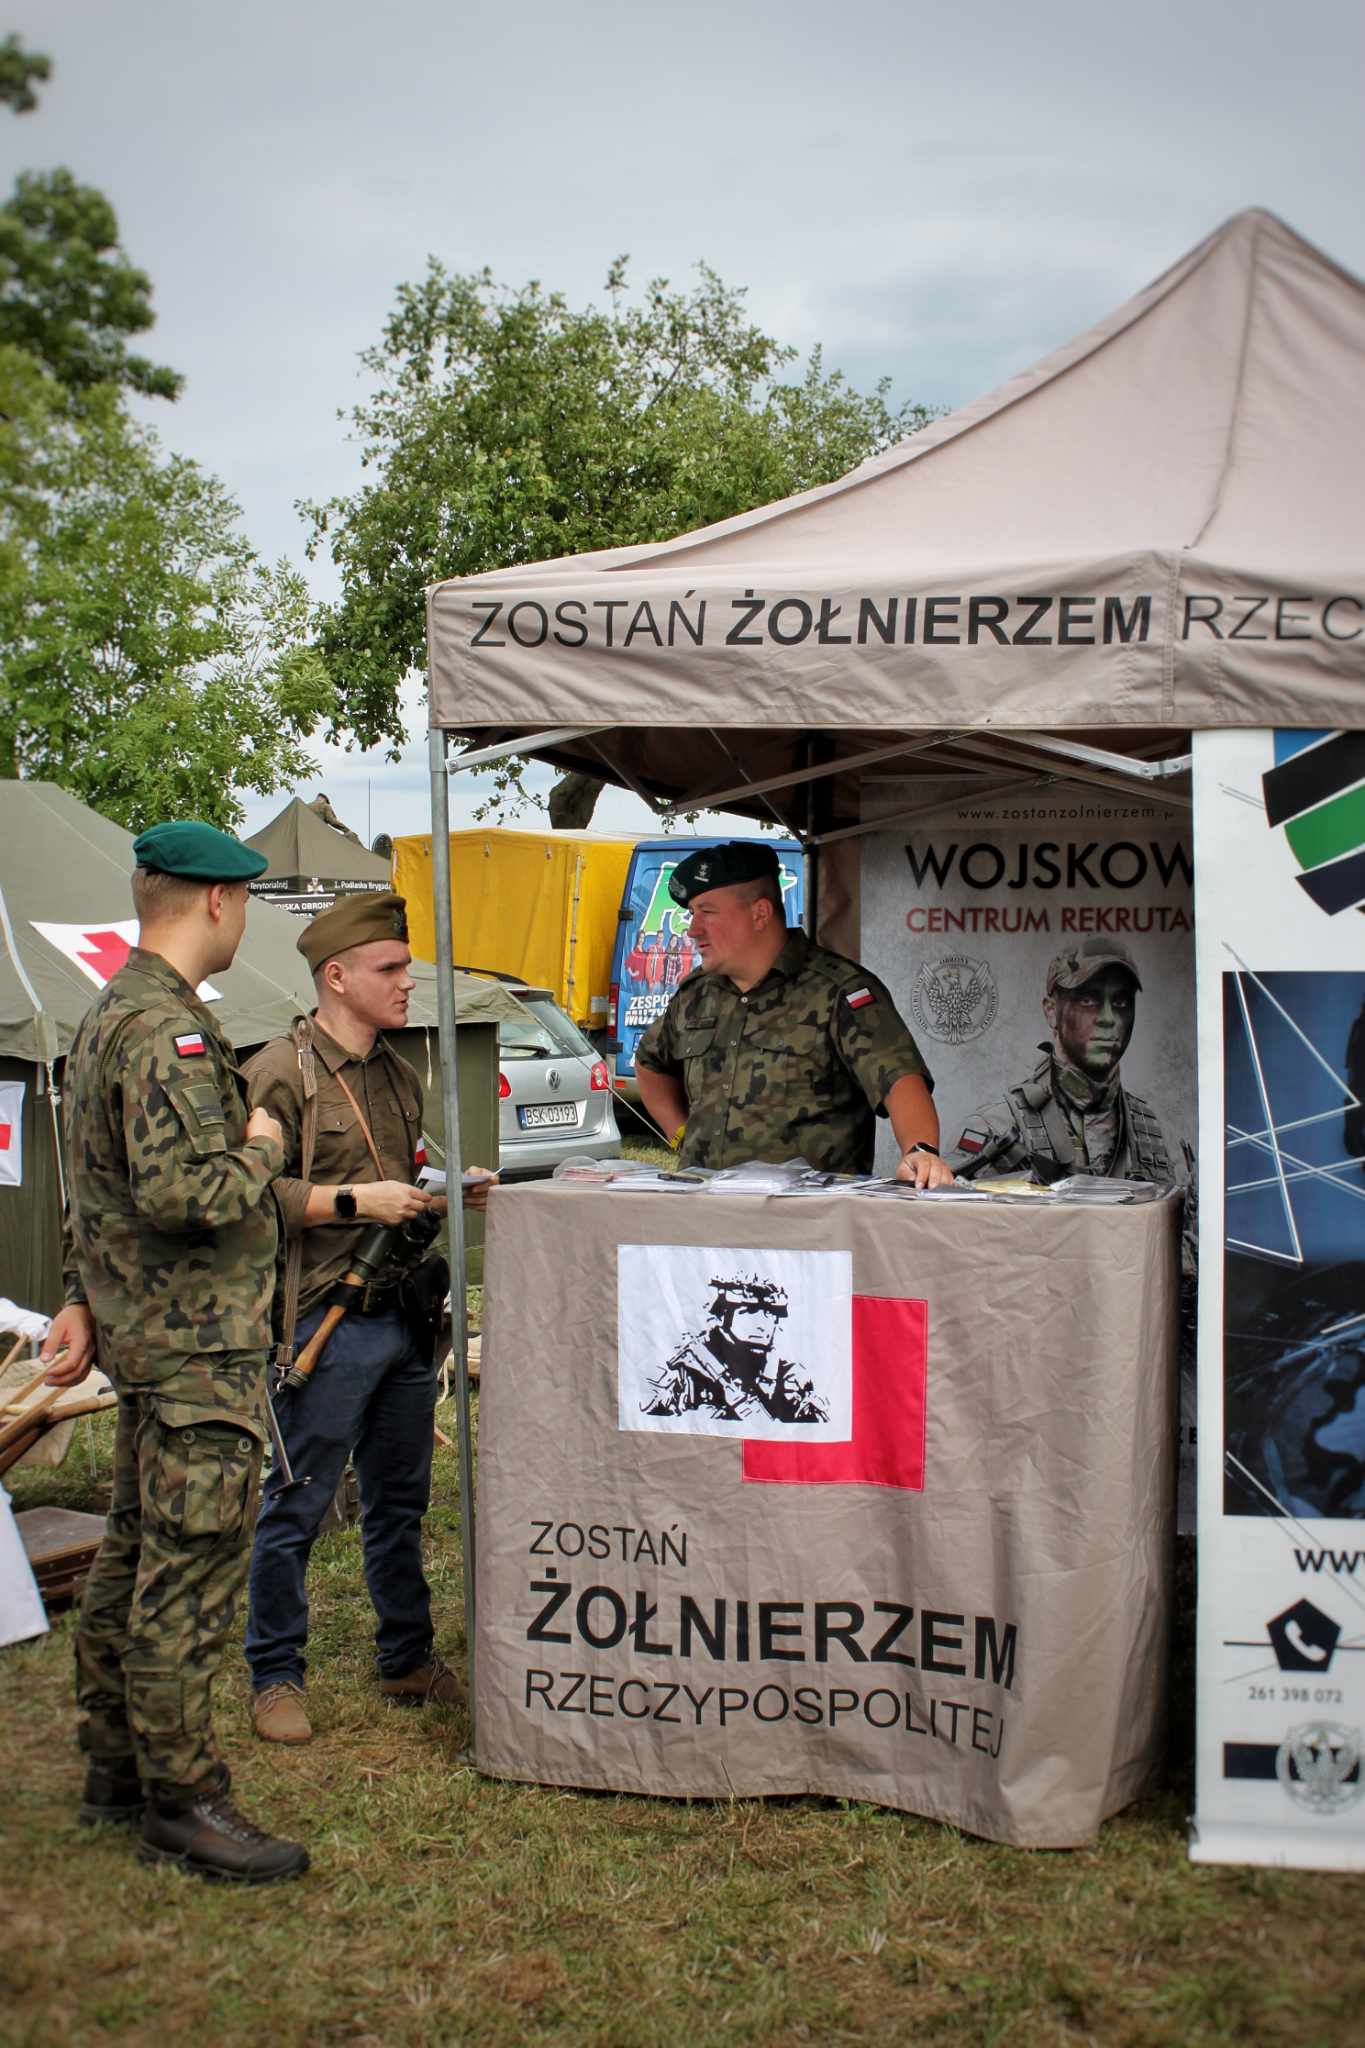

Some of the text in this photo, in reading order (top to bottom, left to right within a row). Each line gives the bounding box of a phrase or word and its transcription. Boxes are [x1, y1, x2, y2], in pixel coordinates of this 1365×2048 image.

[470, 589, 707, 648] ZOSTAŃ
[725, 589, 1152, 646] ŻOŁNIERZEM
[956, 804, 1176, 820] www.zostanzolnierzem.p
[906, 906, 1195, 933] CENTRUM REKRUTA
[629, 991, 673, 1010] ZESPÓ
[526, 1105, 576, 1125] BSK 03193
[529, 1520, 688, 1568] ZOSTAŃ
[526, 1566, 1018, 1690] ŻOŁNIERZEM
[524, 1668, 1004, 1760] RZECZYPOSPOLITEJ
